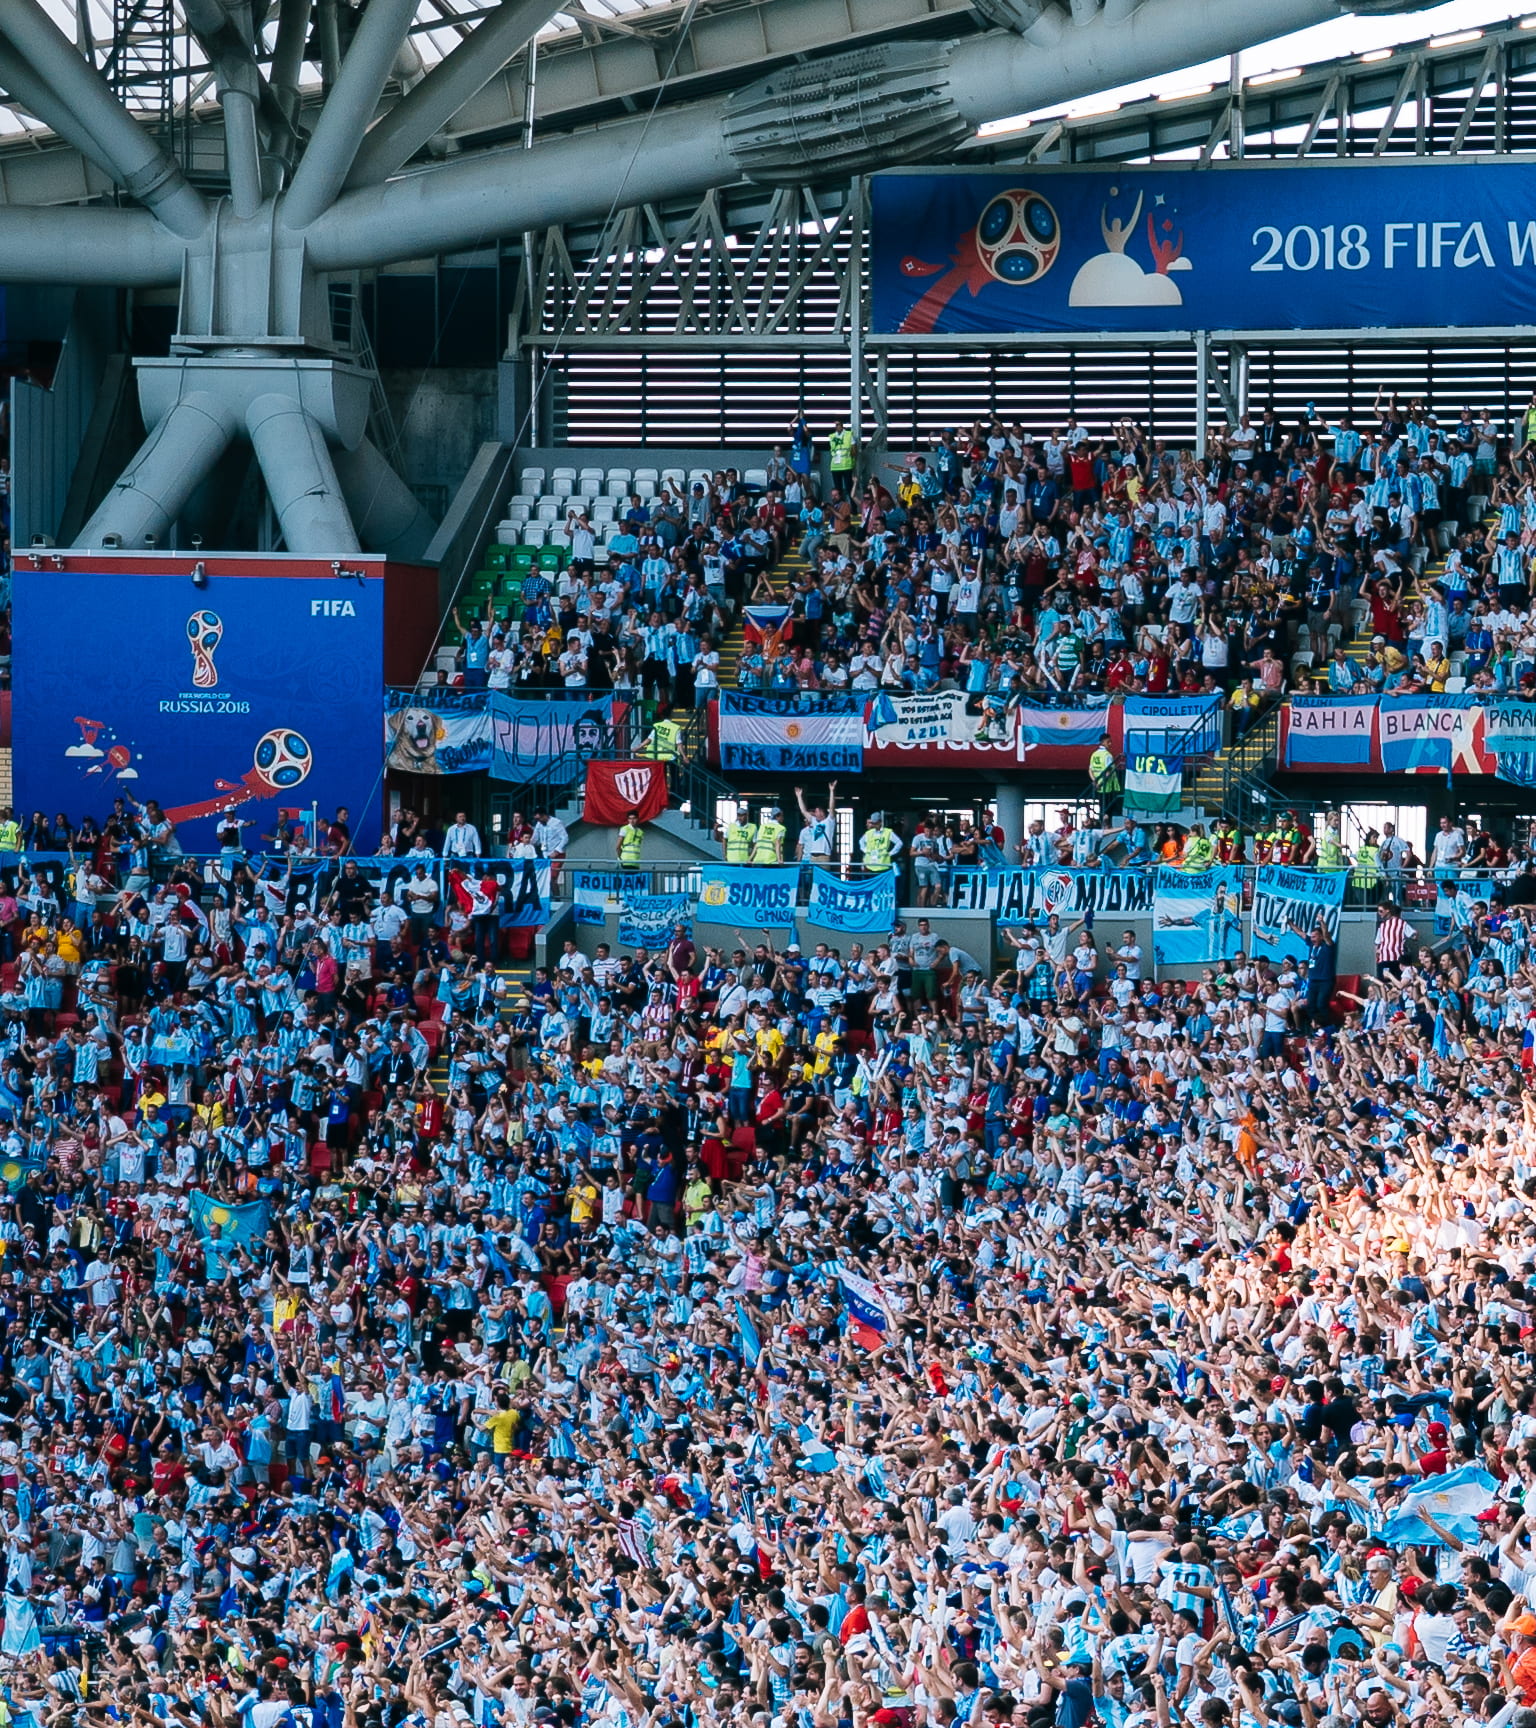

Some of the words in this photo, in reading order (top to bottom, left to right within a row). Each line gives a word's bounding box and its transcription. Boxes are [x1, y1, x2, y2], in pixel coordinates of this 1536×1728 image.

[1251, 225, 1370, 272] 2018
[1385, 220, 1495, 270] FIFA
[311, 600, 356, 617] FIFA
[159, 700, 214, 714] RUSSIA
[216, 700, 250, 714] 2018
[1291, 710, 1366, 729] BAHIA
[1386, 713, 1463, 735] BLANCA
[907, 726, 948, 739] AZUL
[1135, 755, 1168, 775] UFA
[729, 882, 791, 908] SOMOS
[818, 883, 872, 911] SALTA
[952, 870, 1038, 921] FILIAL
